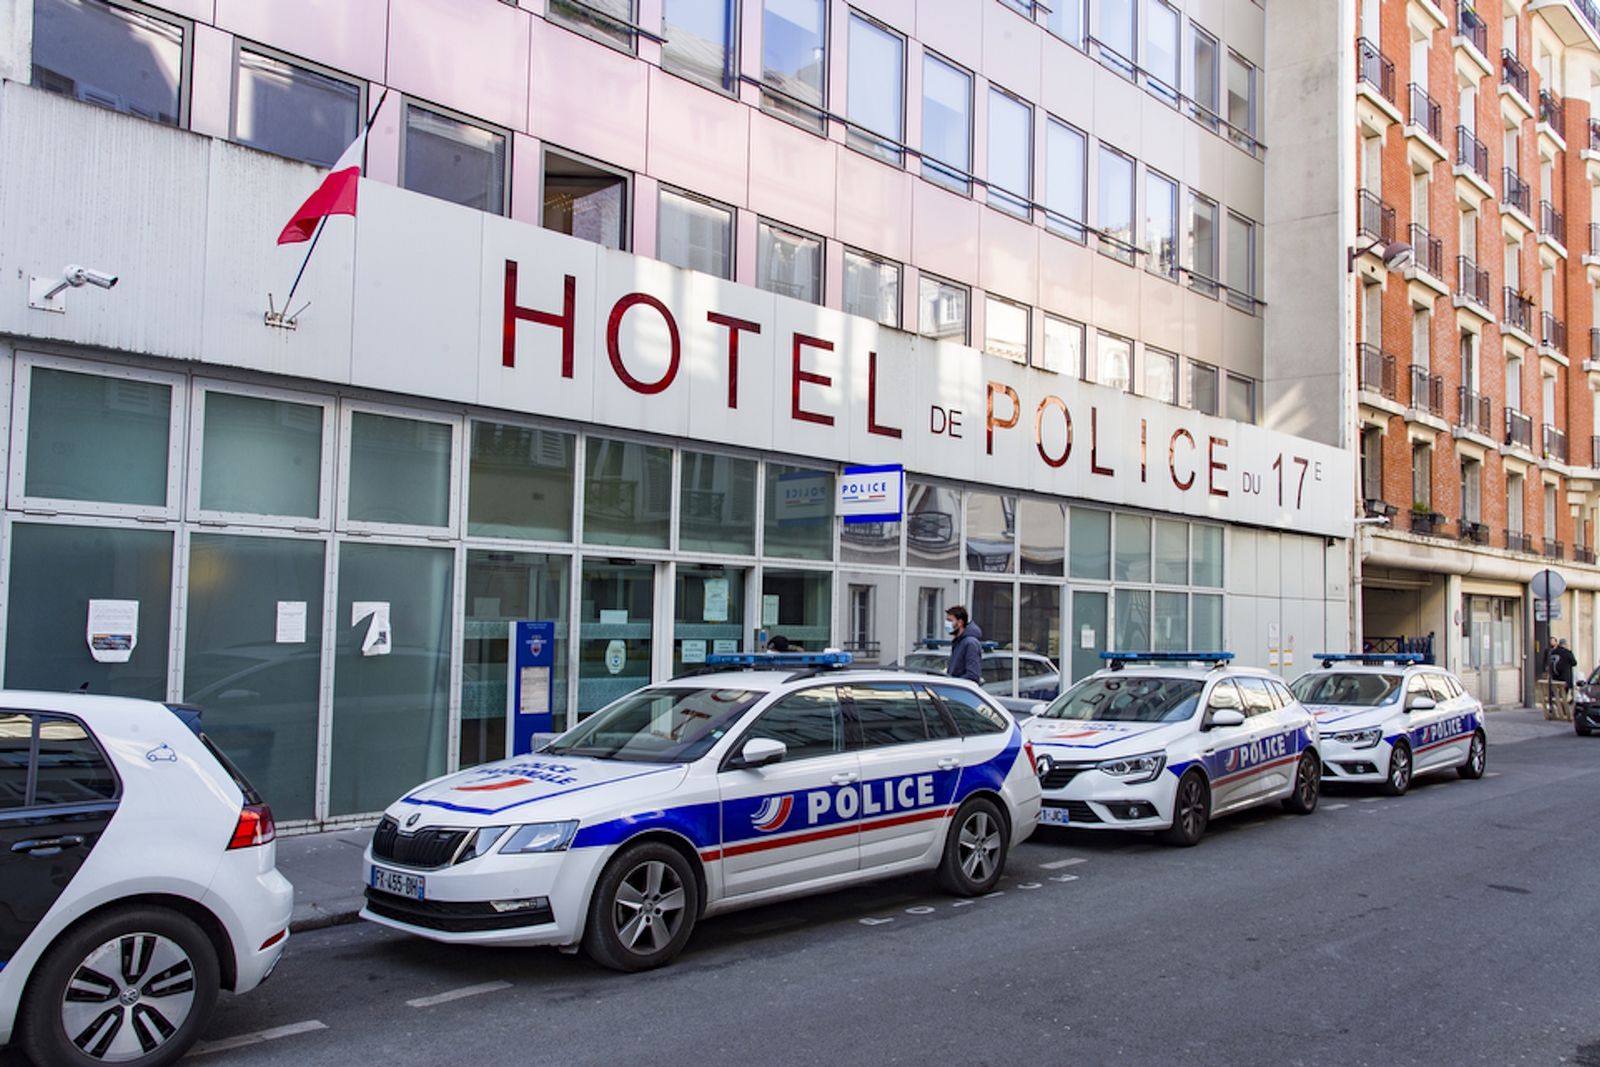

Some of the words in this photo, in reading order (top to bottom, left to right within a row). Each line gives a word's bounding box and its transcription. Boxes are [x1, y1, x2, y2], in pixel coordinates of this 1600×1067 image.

[502, 259, 902, 439] HOTEL
[930, 405, 963, 439] DE
[986, 380, 1229, 498] POLICE
[1242, 471, 1261, 495] DU
[842, 482, 887, 494] POLICE
[1431, 717, 1462, 741] POLICE
[1240, 734, 1286, 768] POLICE
[807, 774, 935, 825] POLICE
